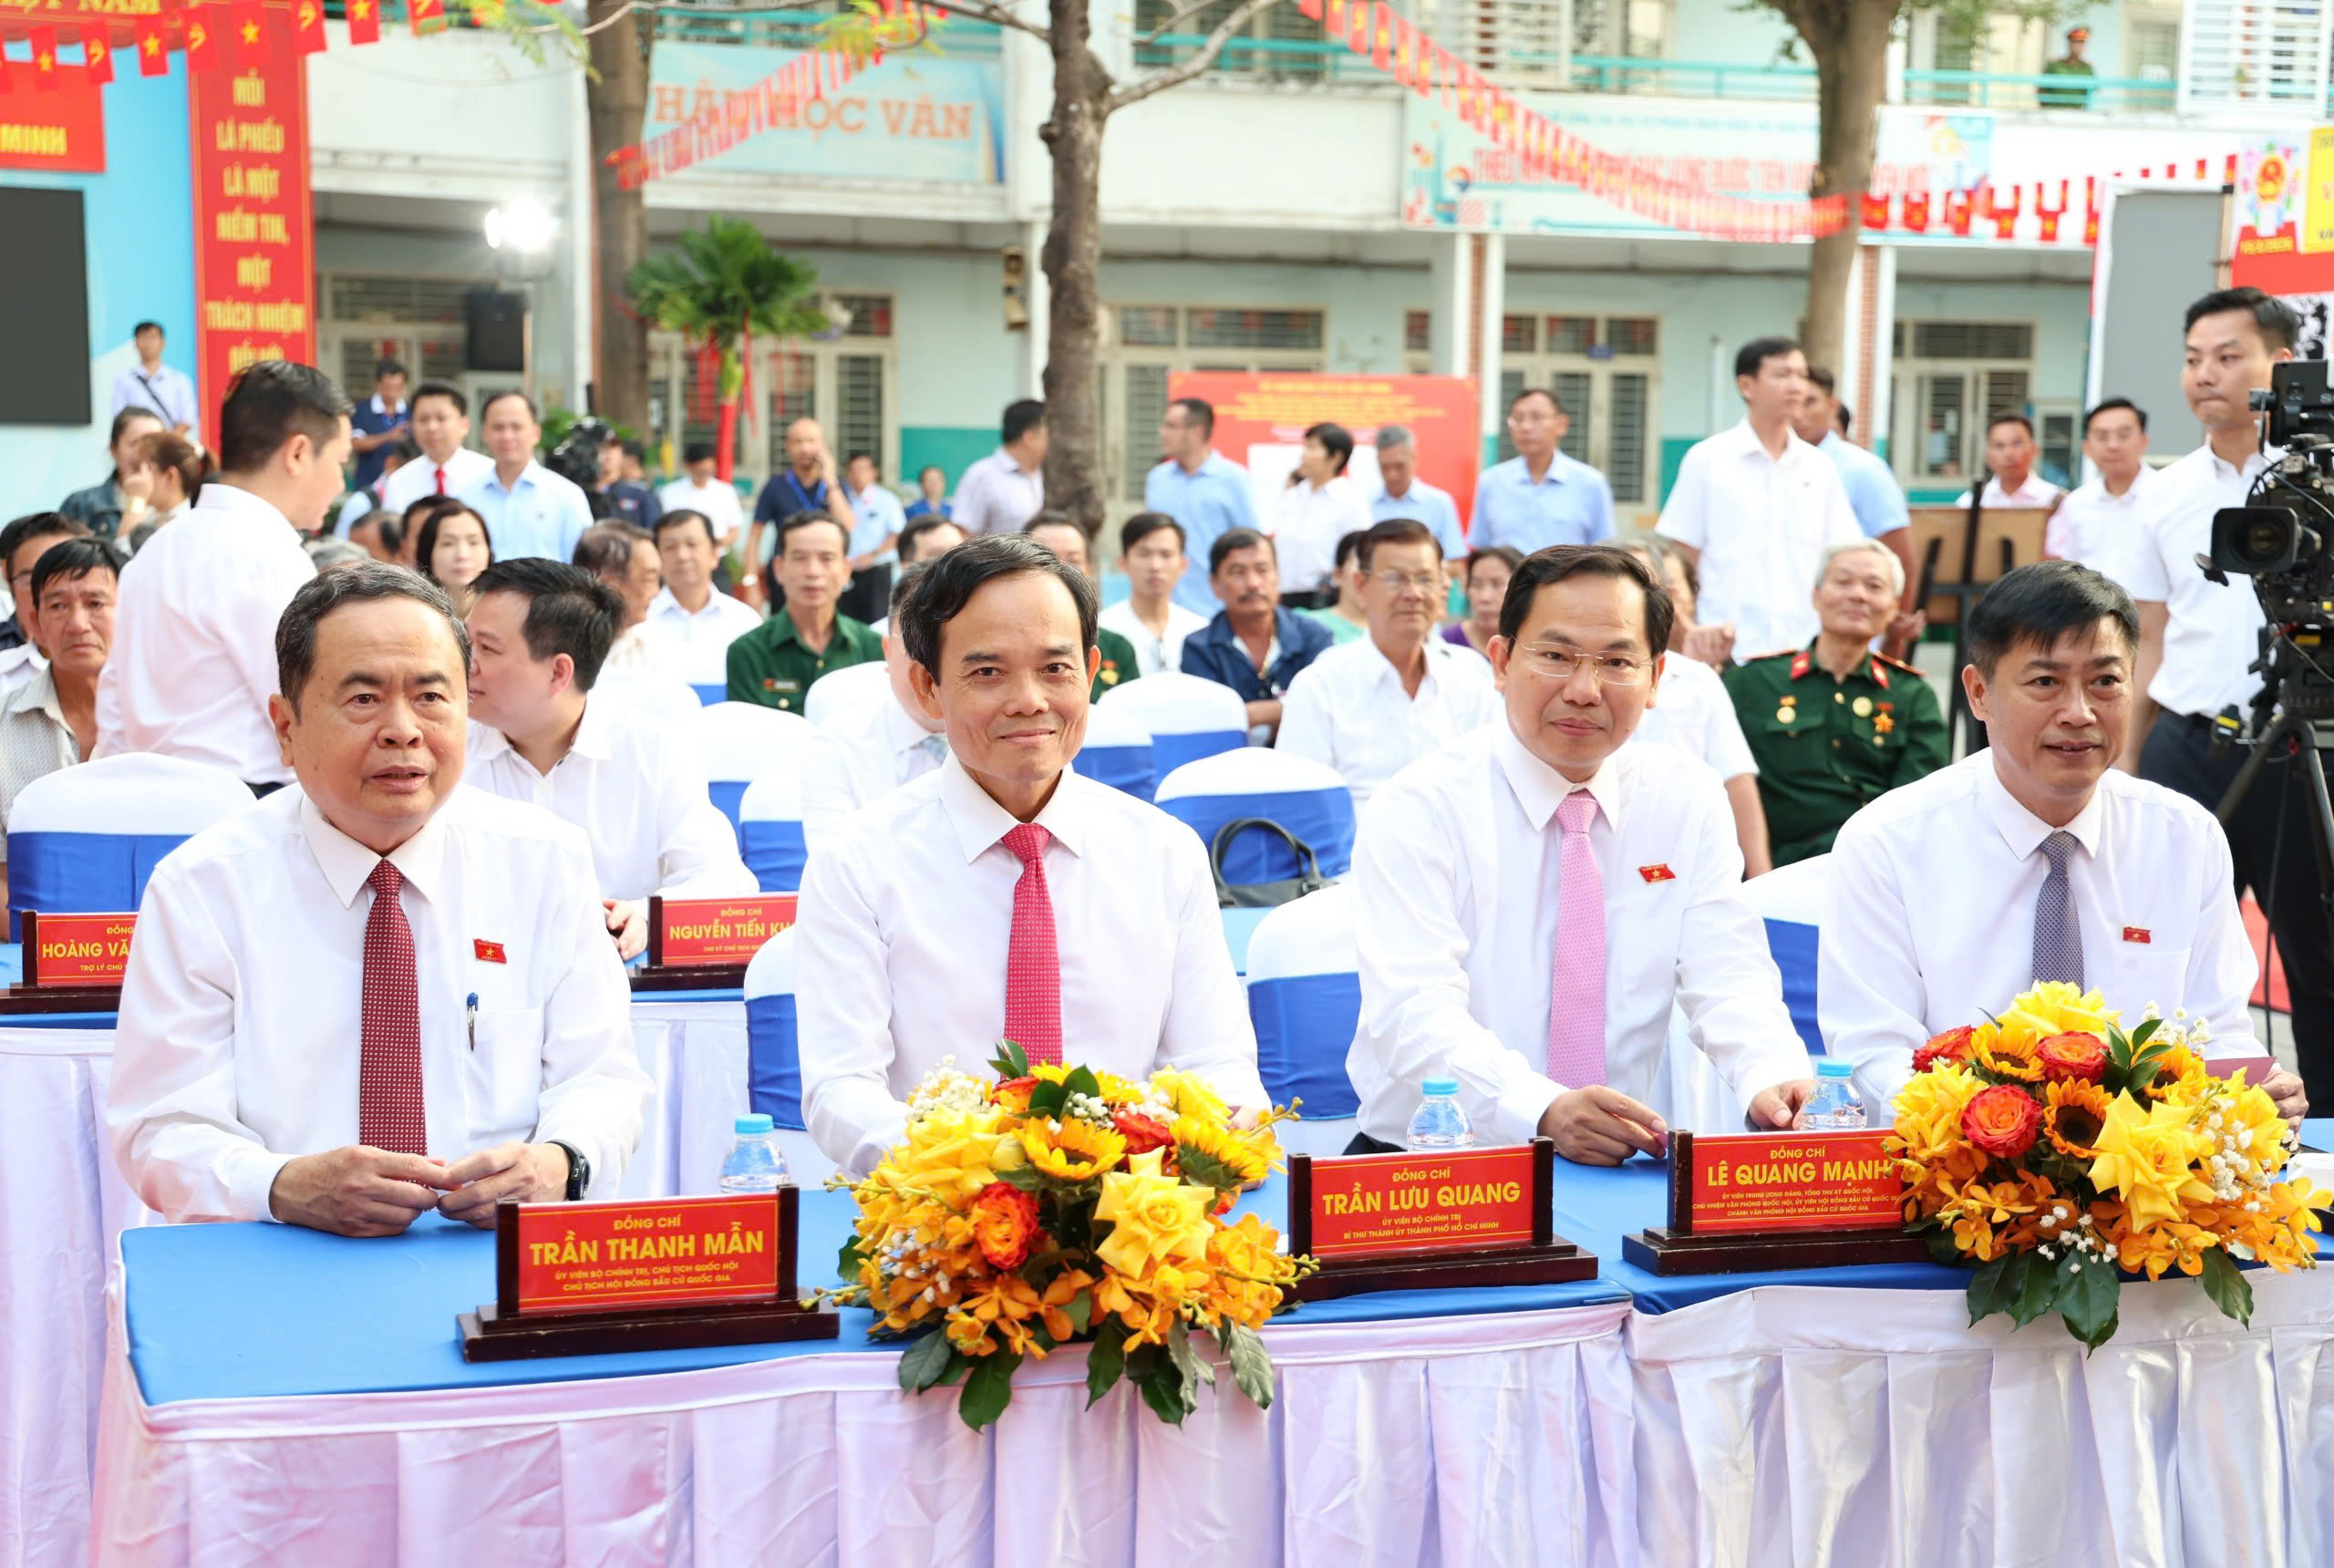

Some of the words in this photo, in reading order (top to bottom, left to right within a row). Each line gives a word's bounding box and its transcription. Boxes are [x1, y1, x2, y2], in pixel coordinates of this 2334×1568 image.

[720, 905, 745, 916] ĐỒNG
[747, 906, 762, 915] CHÍ
[669, 919, 731, 940] NGUYỄN
[735, 918, 765, 937] TIẾN
[769, 922, 794, 935] KH
[42, 939, 103, 958] HOÀNG
[108, 938, 129, 956] VĂ
[107, 962, 123, 971] CHỦ
[1770, 1145, 1803, 1160] ĐỒNG
[1805, 1145, 1825, 1158] CHÍ
[1392, 1167, 1427, 1181] ĐỒNG
[1430, 1167, 1451, 1180] CHÍ
[1708, 1160, 1729, 1186] LÊ
[1735, 1161, 1816, 1185] QUANG
[1823, 1160, 1889, 1187] MẠNH
[1322, 1181, 1381, 1215] TRẦN
[1389, 1185, 1429, 1211] LƯU
[1436, 1181, 1521, 1207] QUANG
[614, 1214, 654, 1231] ĐỒNG
[656, 1213, 682, 1228] CHÍ
[1393, 1215, 1410, 1224] VIÊN
[1412, 1214, 1422, 1224] BỘ
[1425, 1213, 1449, 1222] CHÍNH
[1352, 1231, 1367, 1239] THƯ
[1368, 1228, 1394, 1237] THÀNH
[1407, 1226, 1431, 1234] THÀNH
[1433, 1222, 1450, 1233] PHỐ
[1464, 1222, 1477, 1230] CHÍ
[530, 1230, 598, 1266] TRẦN
[605, 1233, 696, 1262] THANH
[704, 1221, 763, 1255] MẪN
[604, 1266, 634, 1276] CHÍNH
[694, 1261, 720, 1272] QUỐC
[687, 1273, 713, 1284] QUỐC
[715, 1274, 730, 1283] GIA
